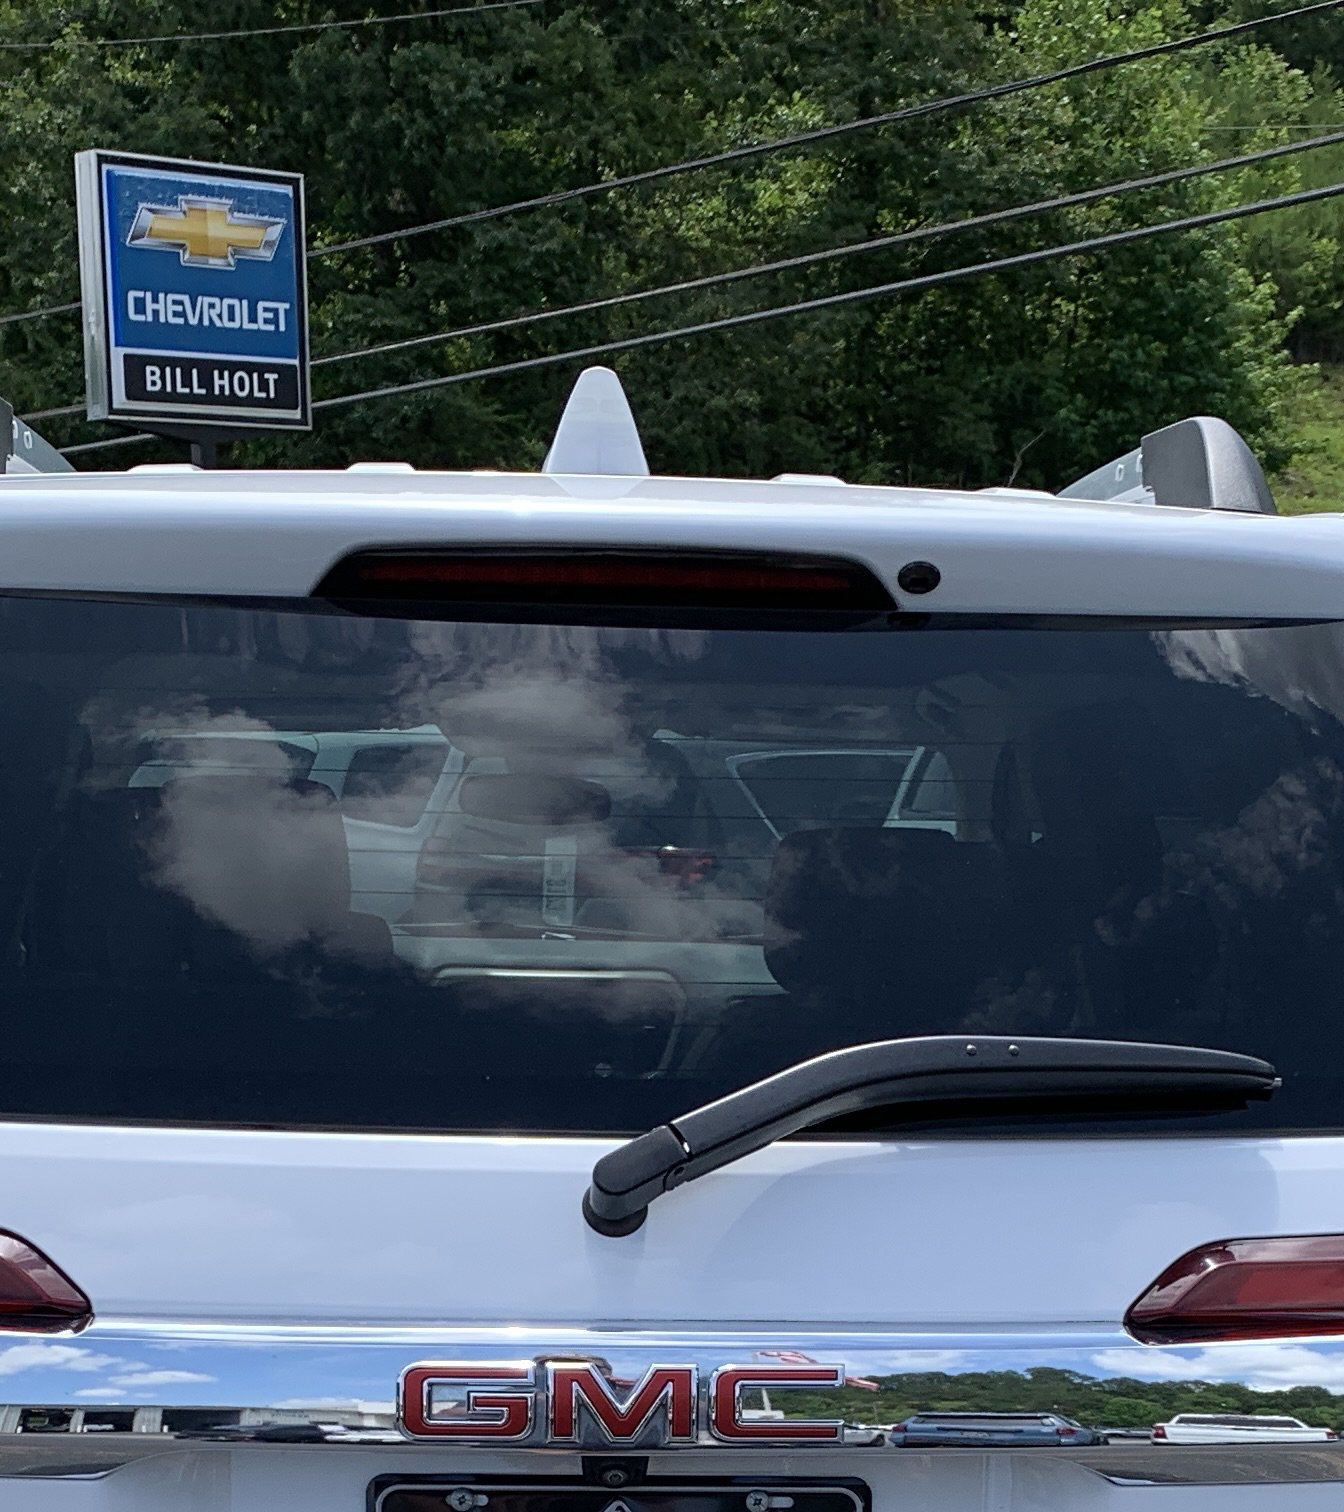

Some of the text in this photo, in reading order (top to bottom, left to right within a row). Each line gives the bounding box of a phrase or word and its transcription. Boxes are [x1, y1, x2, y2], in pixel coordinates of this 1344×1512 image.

[127, 290, 290, 332] CHEVROLET
[145, 365, 279, 399] BILL HOLT
[396, 1359, 846, 1444] GMC
